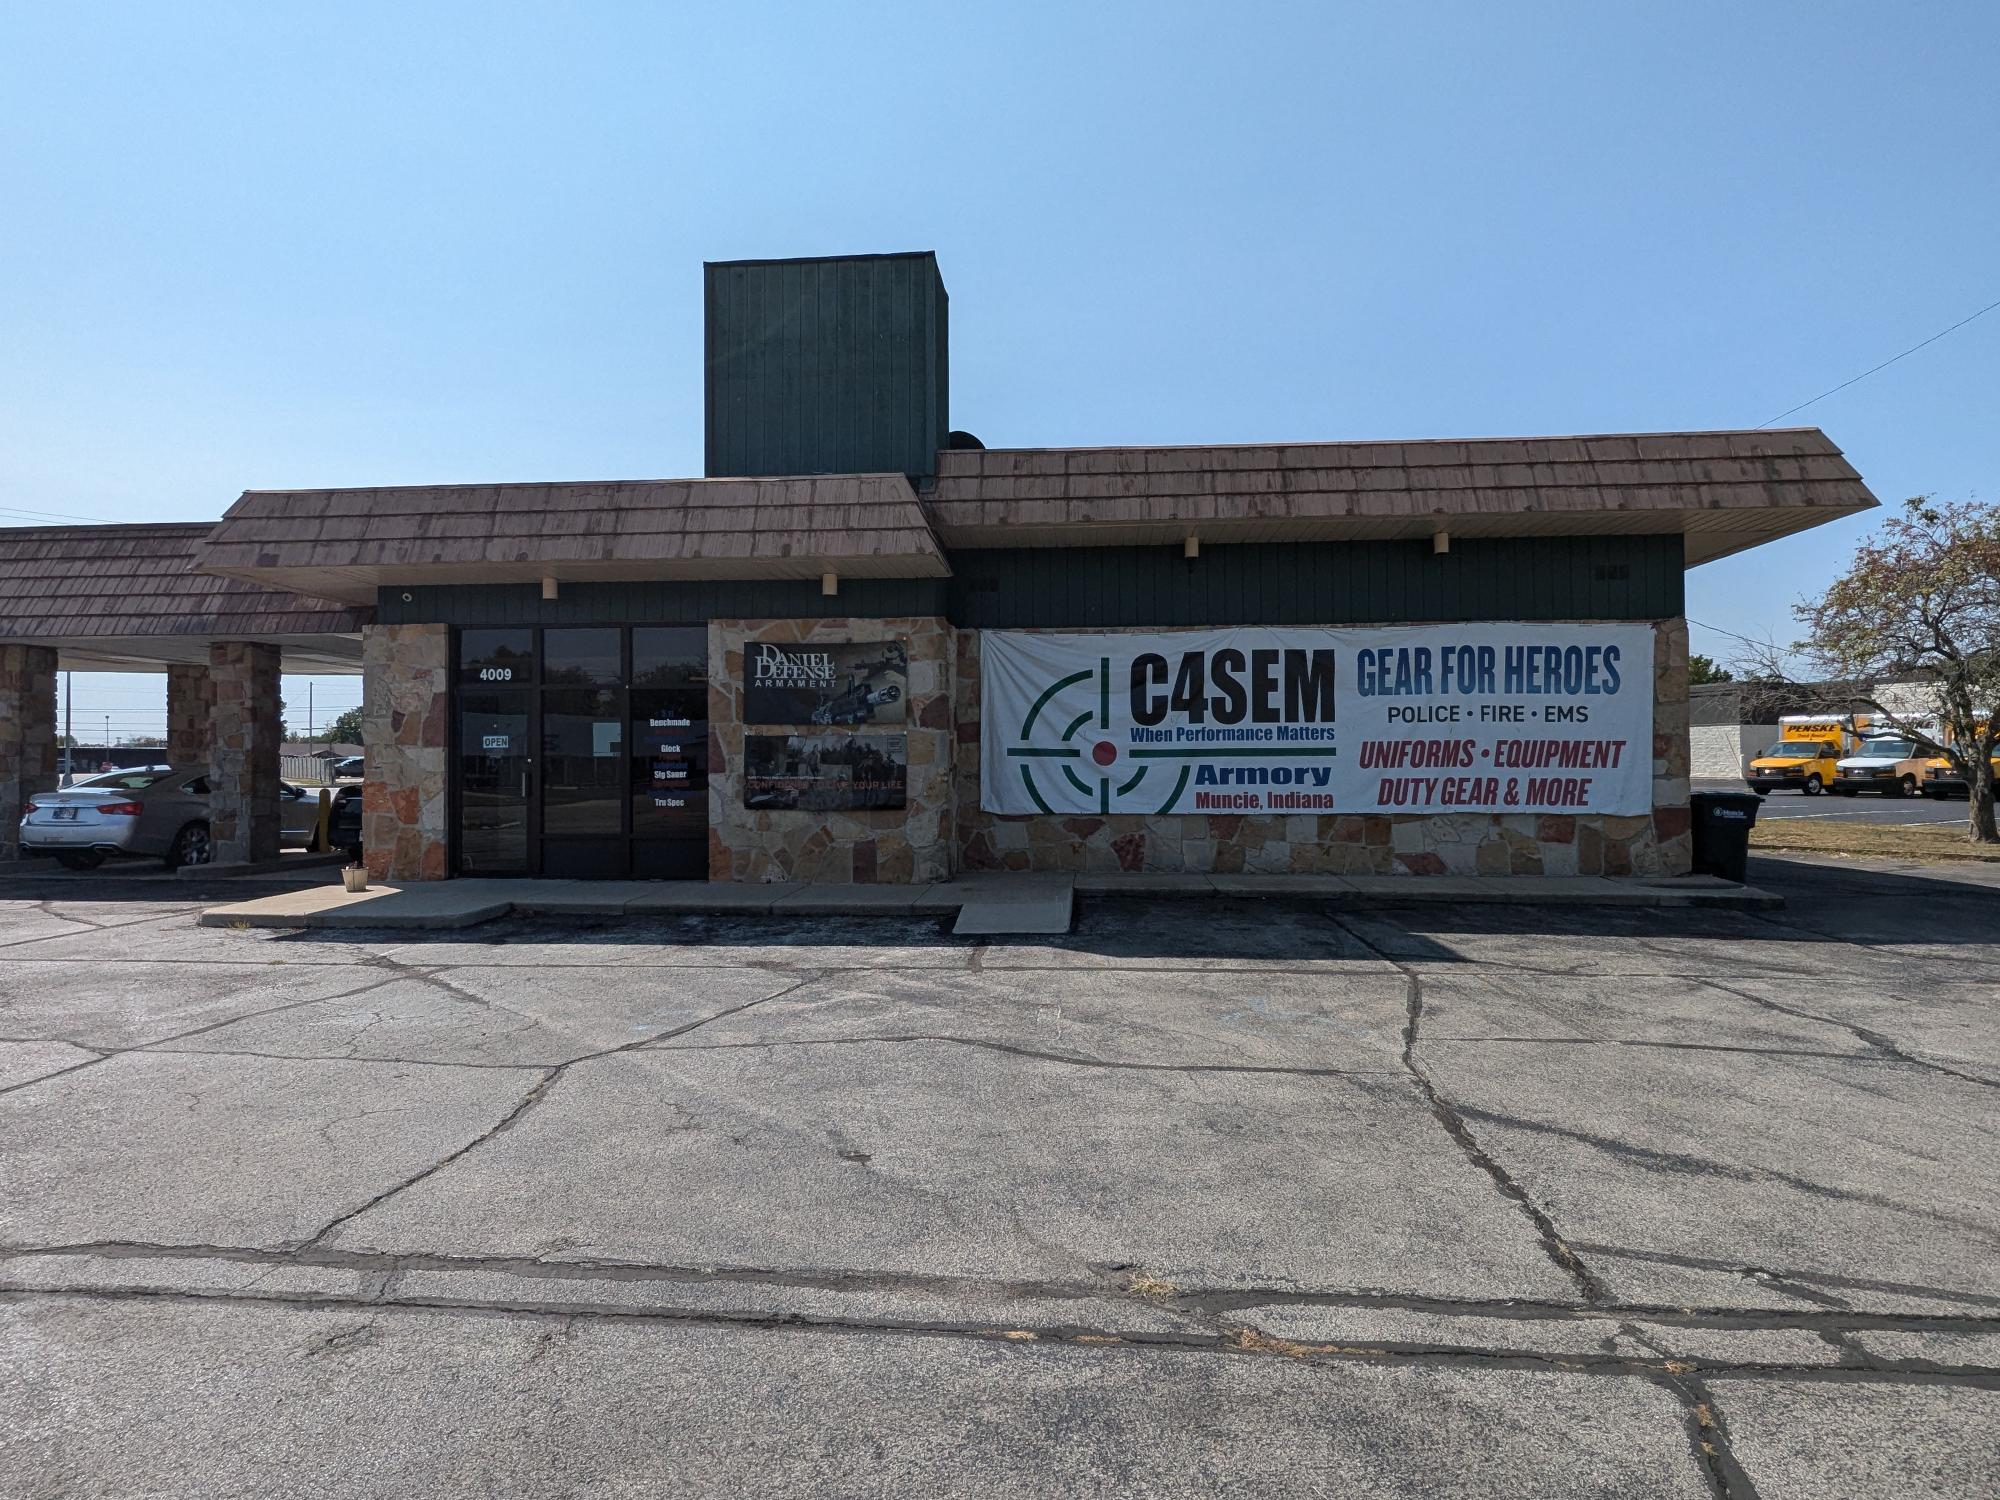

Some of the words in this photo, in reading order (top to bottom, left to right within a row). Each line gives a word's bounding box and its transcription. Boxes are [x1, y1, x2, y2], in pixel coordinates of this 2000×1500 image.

[760, 644, 835, 667] DANIEL
[480, 668, 512, 680] 4009
[754, 656, 837, 680] DEFENSE
[1357, 648, 1433, 697] GEAR
[1441, 645, 1496, 695] FOR
[1504, 645, 1621, 695] HEROES
[754, 680, 837, 688] ARMAMENT
[1130, 648, 1336, 726] C4SEM
[649, 719, 691, 727] Benchmade
[1388, 705, 1460, 723] POLICE
[1480, 705, 1525, 723] FIRE
[1544, 705, 1589, 723] EMS
[484, 737, 508, 747] OPEN
[1130, 727, 1173, 742] When
[1176, 726, 1273, 741] Performance
[1276, 725, 1335, 741] Matters
[661, 744, 681, 753] Glock
[1359, 739, 1476, 769] UNIFORMS
[1493, 739, 1626, 769] EQUIPMENT
[654, 771, 666, 780] Sig
[666, 771, 687, 779] Sauer
[1195, 764, 1331, 787] Armory
[1195, 791, 1264, 810] Muncie,
[1267, 791, 1334, 808] Indiana
[1377, 777, 1439, 806] DUTY
[1440, 777, 1499, 806] GEAR
[1503, 777, 1519, 806] &
[1524, 777, 1592, 806] MORE
[667, 799, 685, 808] Spec
